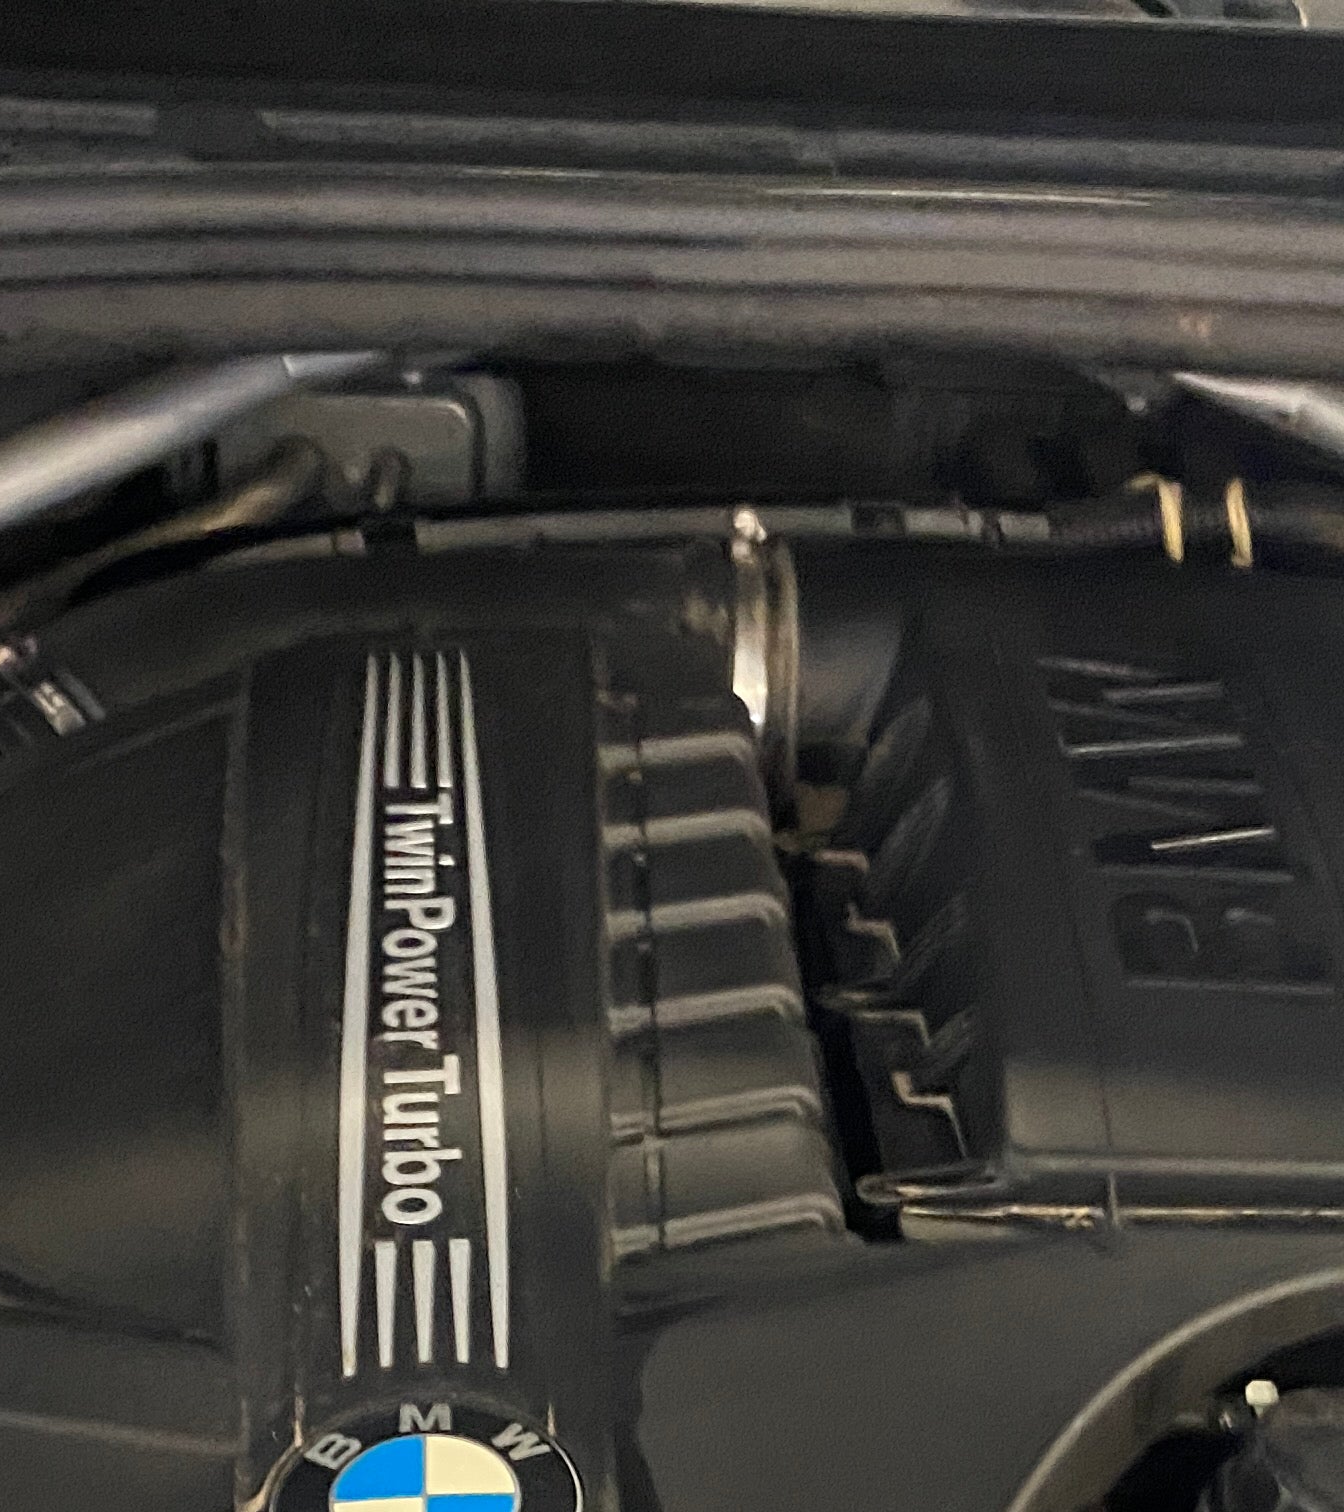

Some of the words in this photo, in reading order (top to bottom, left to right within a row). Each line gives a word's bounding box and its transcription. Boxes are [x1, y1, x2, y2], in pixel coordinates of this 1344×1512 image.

[383, 793, 455, 1051] TwinPower
[381, 1054, 463, 1226] Turbo
[304, 1402, 551, 1470] BMW
